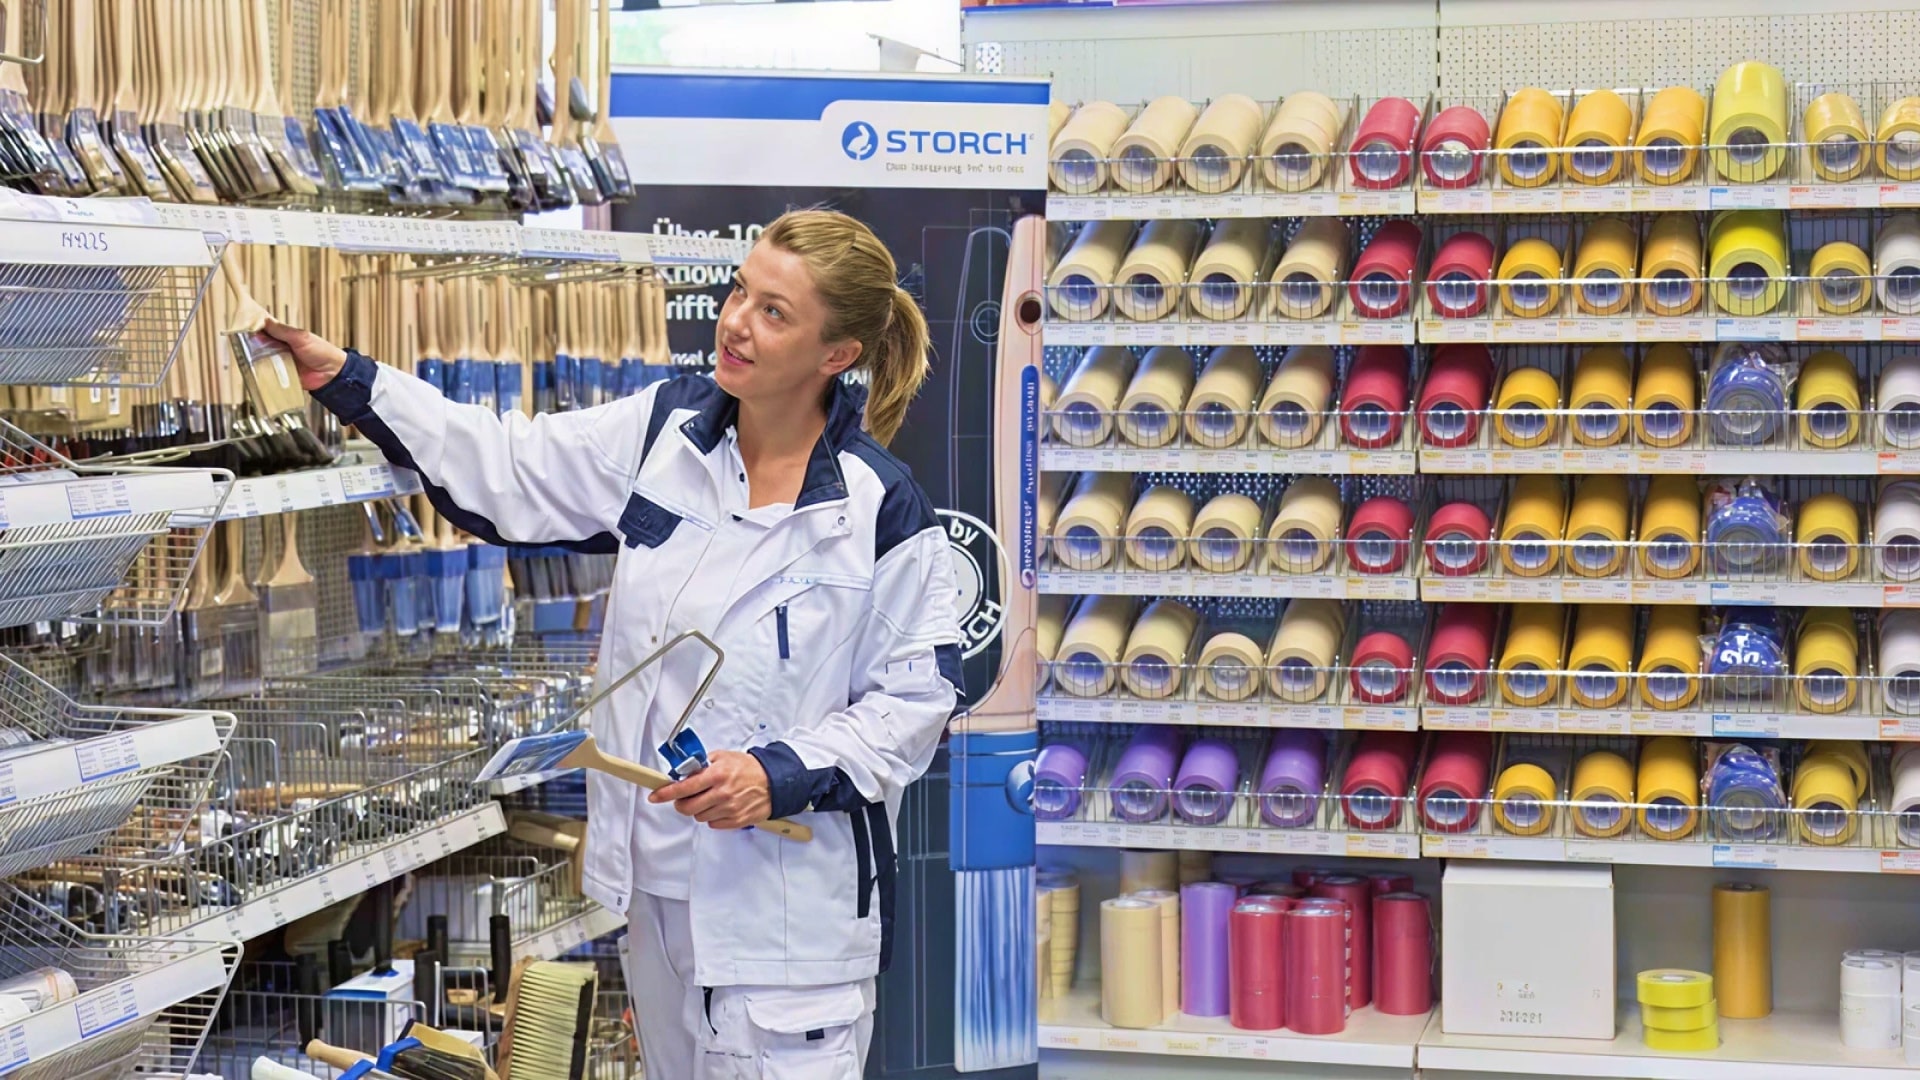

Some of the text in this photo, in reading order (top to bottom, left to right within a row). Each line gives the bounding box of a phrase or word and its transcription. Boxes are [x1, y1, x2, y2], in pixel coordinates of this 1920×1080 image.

[886, 130, 1026, 154] STORCH
[666, 294, 718, 320] rifft
[950, 518, 979, 546] by
